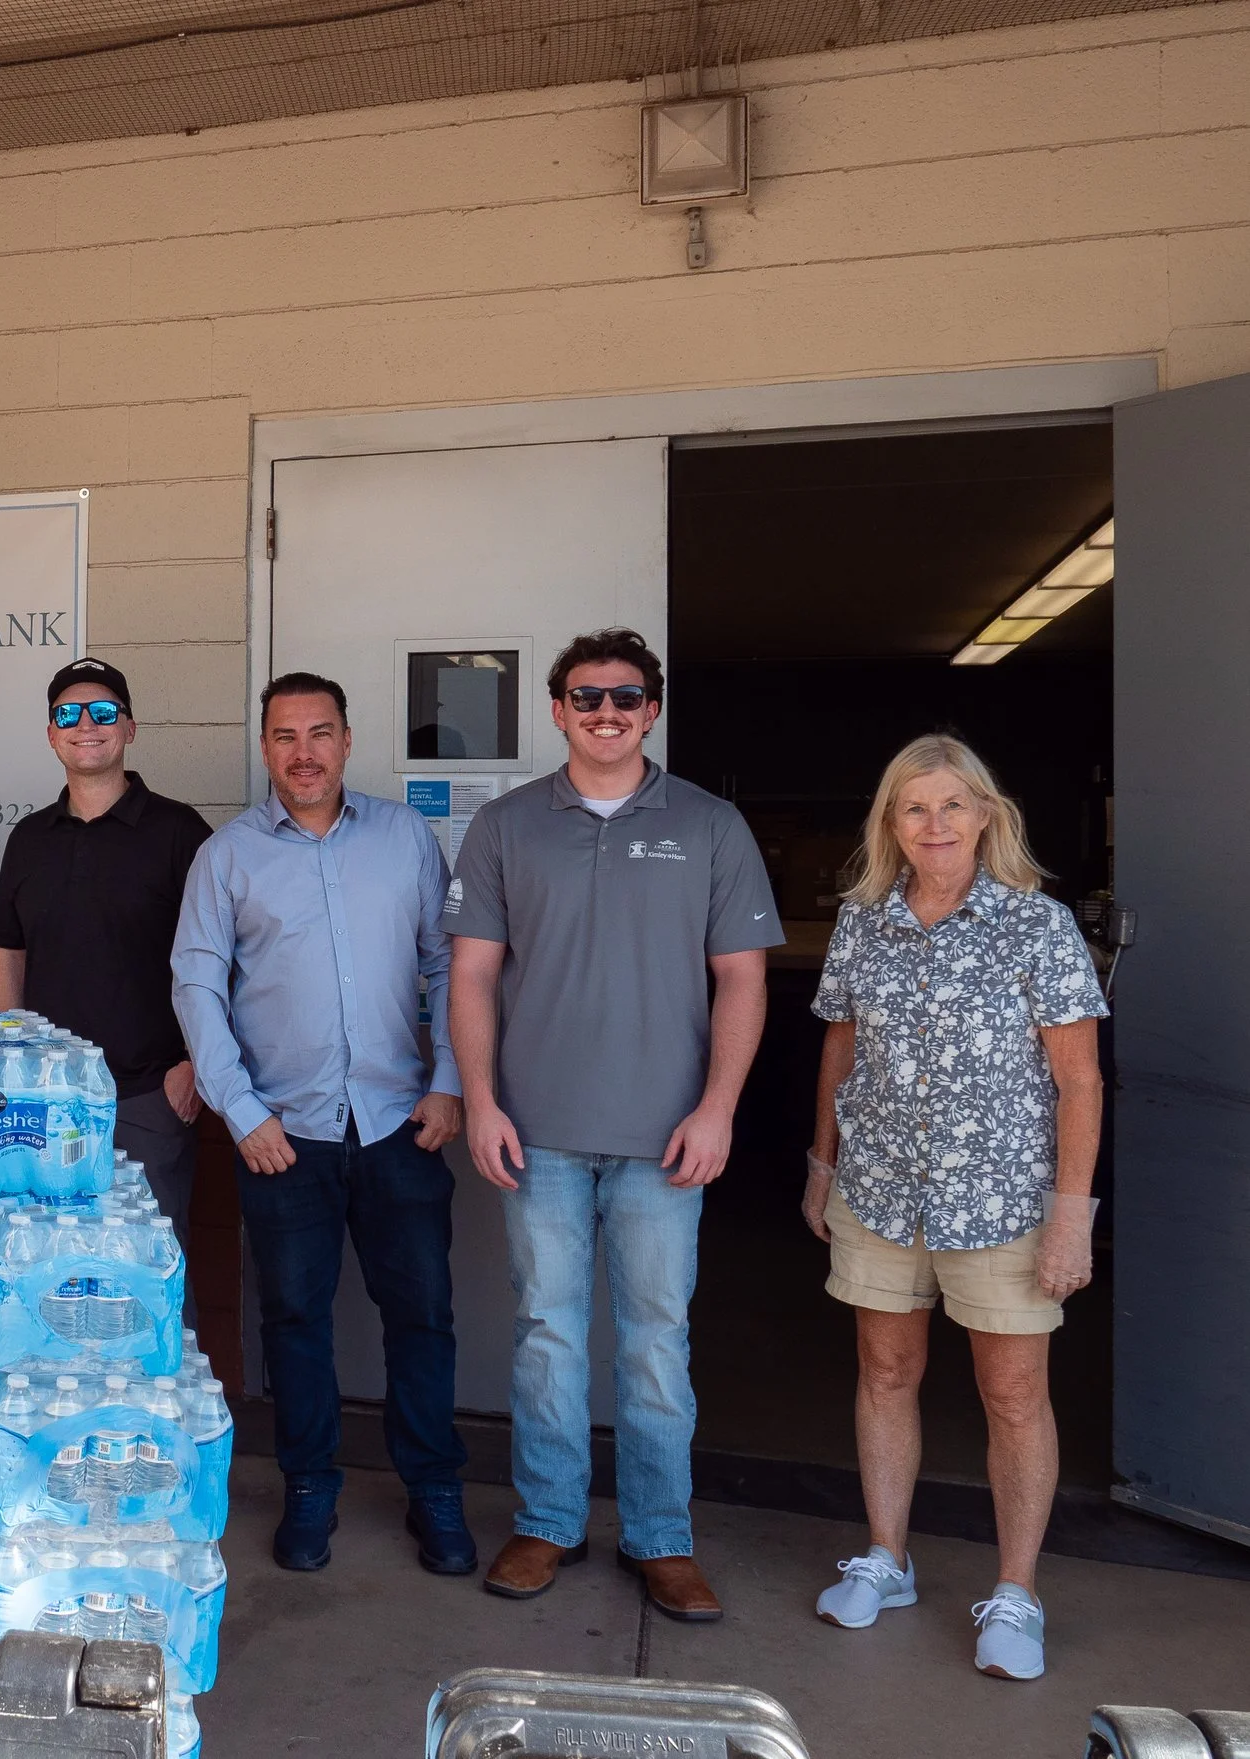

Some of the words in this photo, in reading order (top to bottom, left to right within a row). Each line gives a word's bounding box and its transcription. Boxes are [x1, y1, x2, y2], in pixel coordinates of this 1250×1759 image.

[18, 1136, 45, 1147] water
[555, 1727, 588, 1746] FILL
[592, 1729, 636, 1750] WITH
[642, 1733, 695, 1753] SAND
